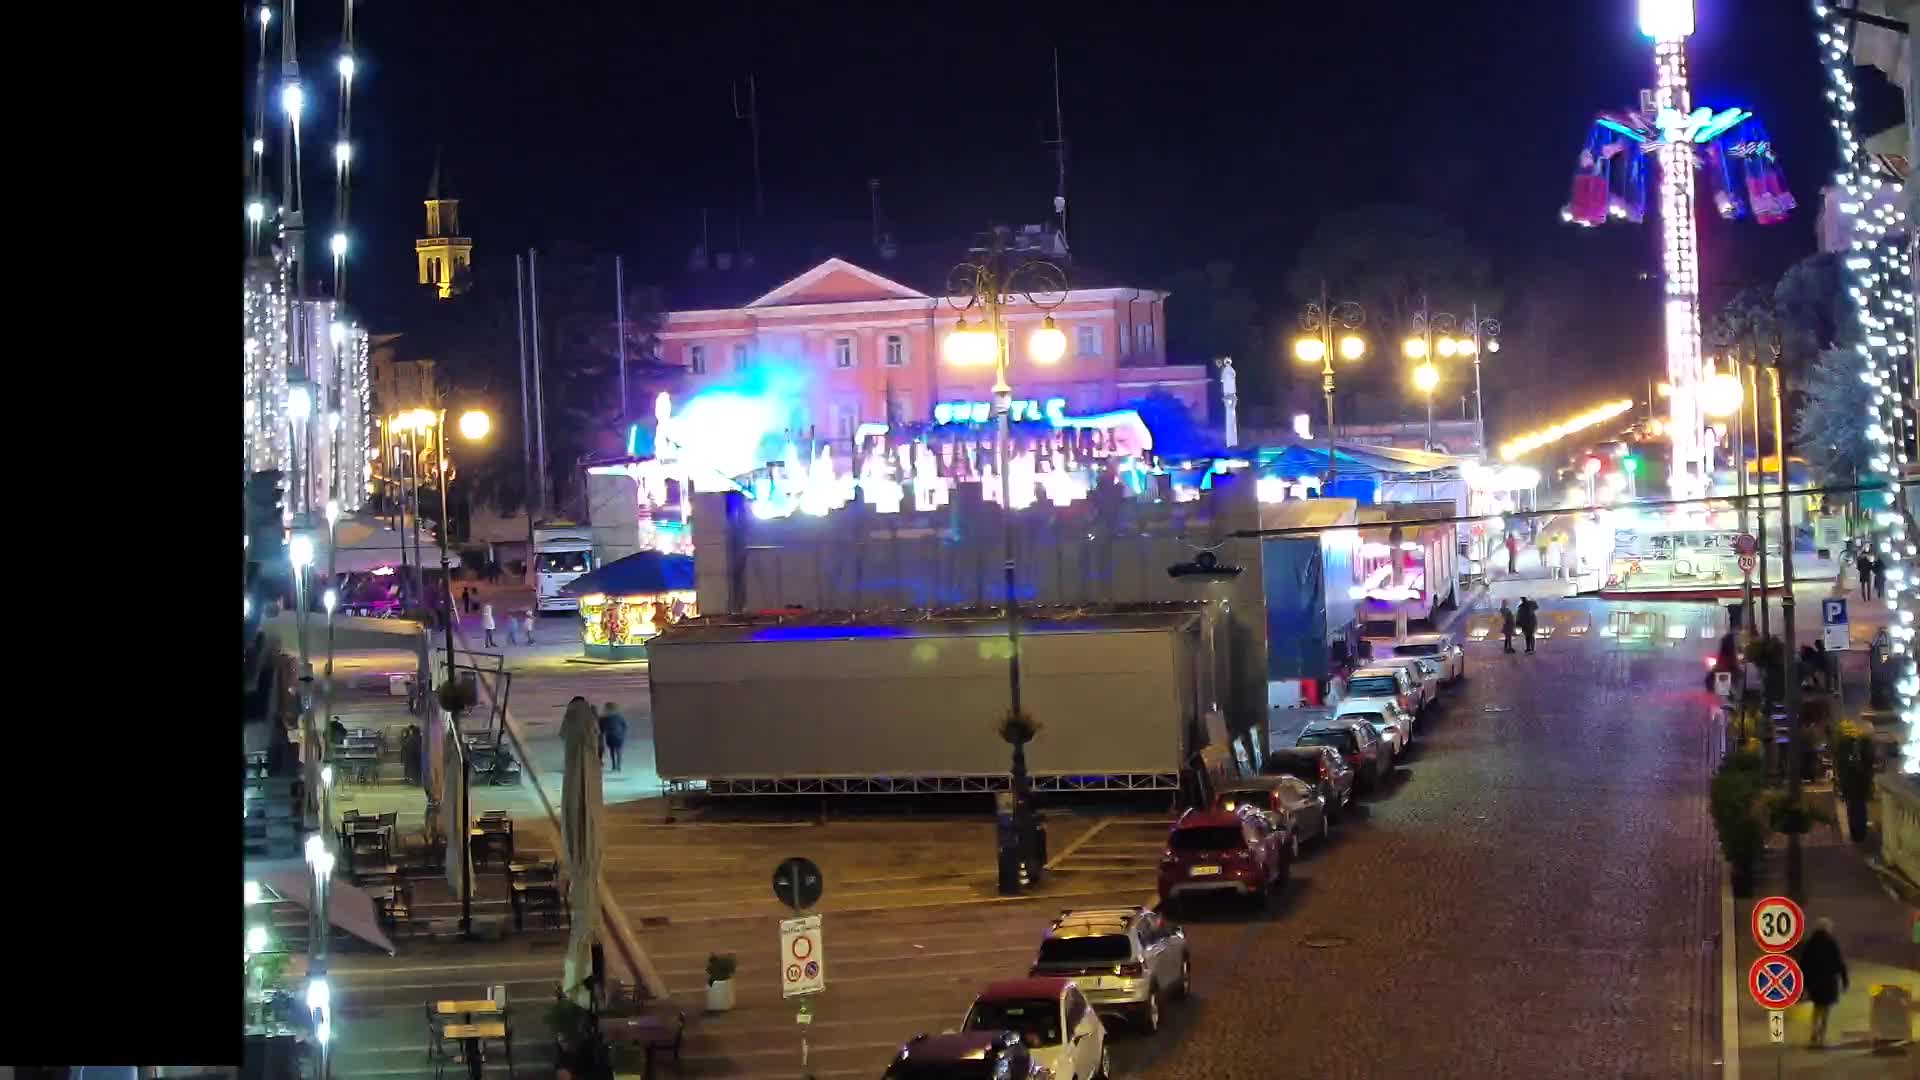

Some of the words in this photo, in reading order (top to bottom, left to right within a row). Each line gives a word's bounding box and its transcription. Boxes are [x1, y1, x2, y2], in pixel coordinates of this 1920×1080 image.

[1741, 557, 1753, 567] 20
[1827, 602, 1842, 622] P
[1762, 912, 1791, 937] 30
